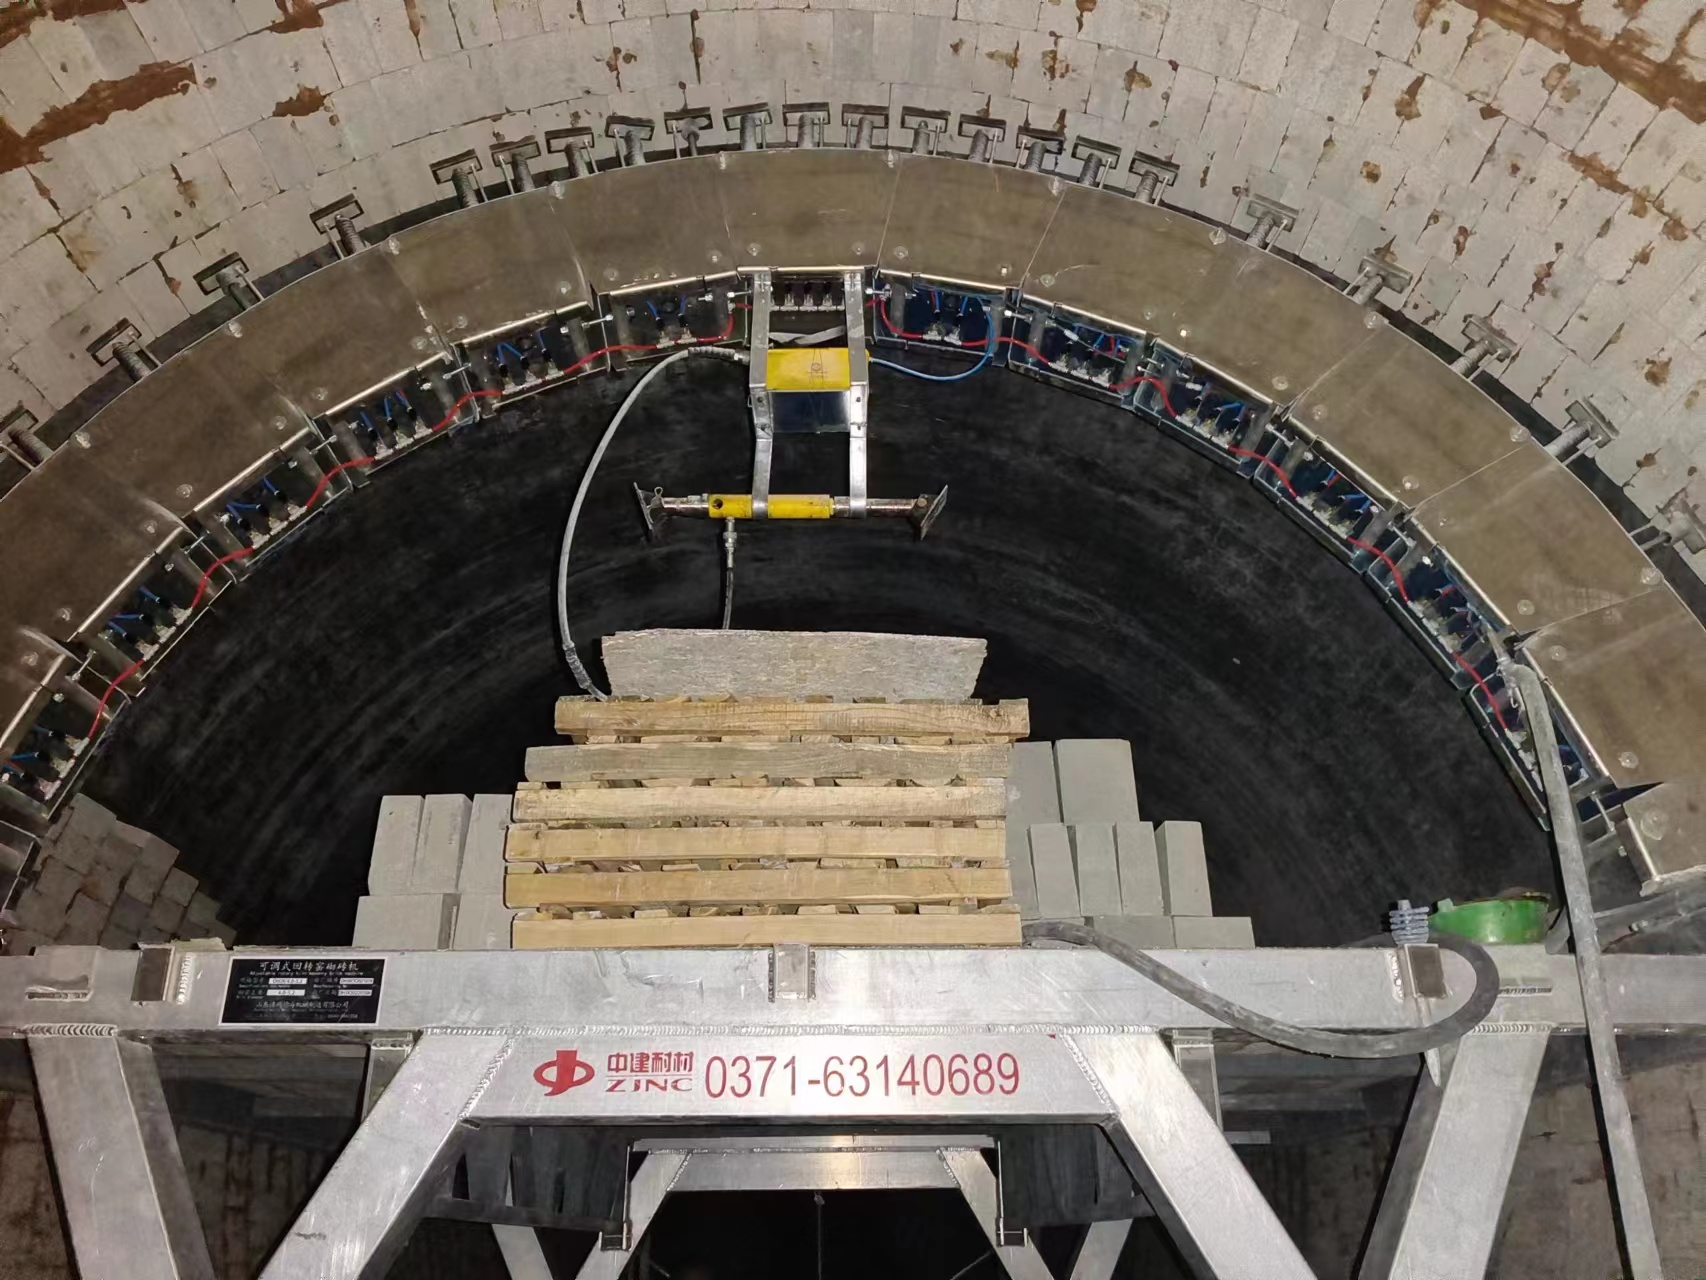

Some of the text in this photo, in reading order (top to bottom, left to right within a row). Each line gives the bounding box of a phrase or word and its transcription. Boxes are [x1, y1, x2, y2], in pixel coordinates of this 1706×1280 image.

[607, 1051, 694, 1073] 中建耐材
[705, 1052, 1020, 1098] 0371-63140689
